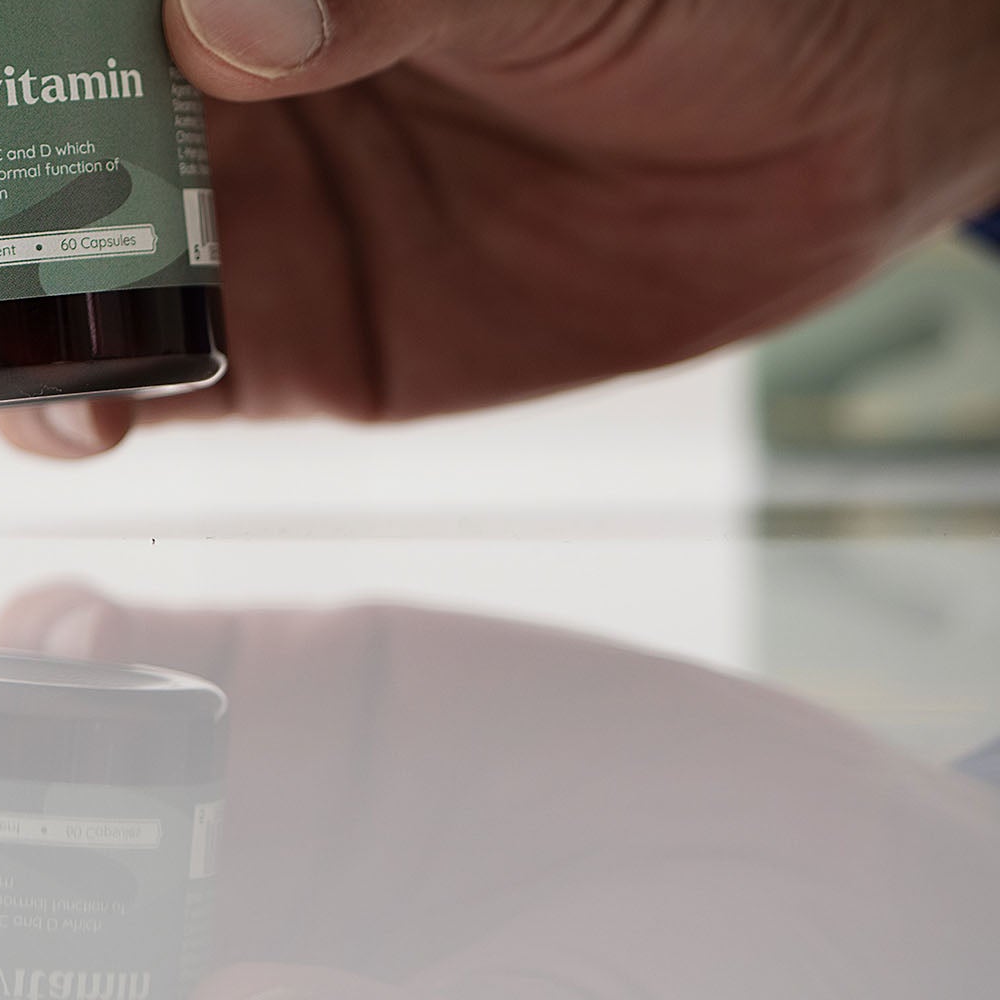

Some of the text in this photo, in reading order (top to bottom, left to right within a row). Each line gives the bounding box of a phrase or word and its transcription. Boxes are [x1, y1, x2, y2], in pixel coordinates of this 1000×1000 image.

[6, 144, 36, 160] and
[40, 144, 52, 157] D
[55, 140, 96, 156] which
[45, 160, 102, 176] function
[105, 157, 119, 172] of
[60, 238, 77, 251] 60
[80, 235, 137, 252] Capsules
